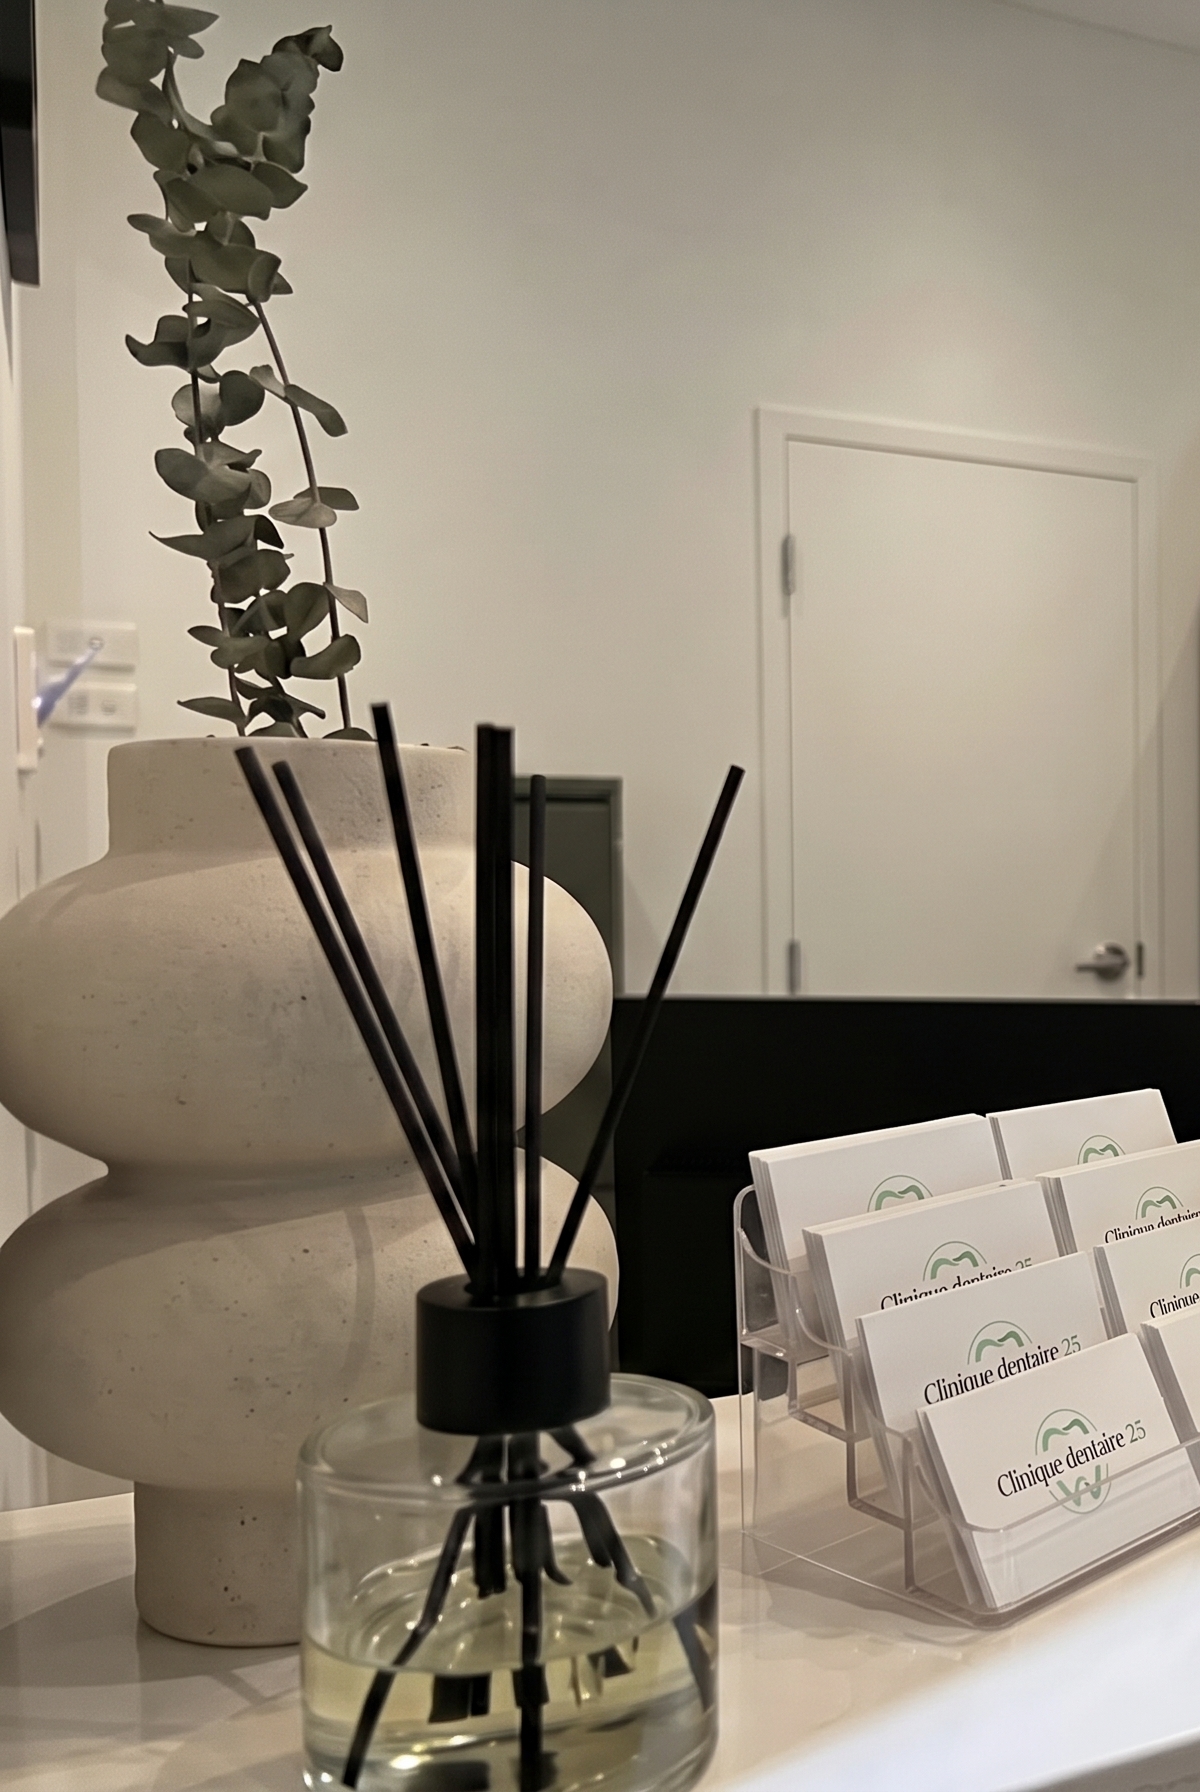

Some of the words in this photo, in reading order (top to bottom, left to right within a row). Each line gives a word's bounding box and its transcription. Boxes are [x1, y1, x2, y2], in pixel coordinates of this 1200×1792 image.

[880, 1286, 948, 1310] Clini
[923, 1368, 995, 1405] Clinique
[997, 1345, 1059, 1380] dentaire
[1061, 1334, 1082, 1357] 25
[997, 1458, 1065, 1497] Clinique
[1065, 1432, 1126, 1469] dentaire
[1125, 1419, 1147, 1444] 25
